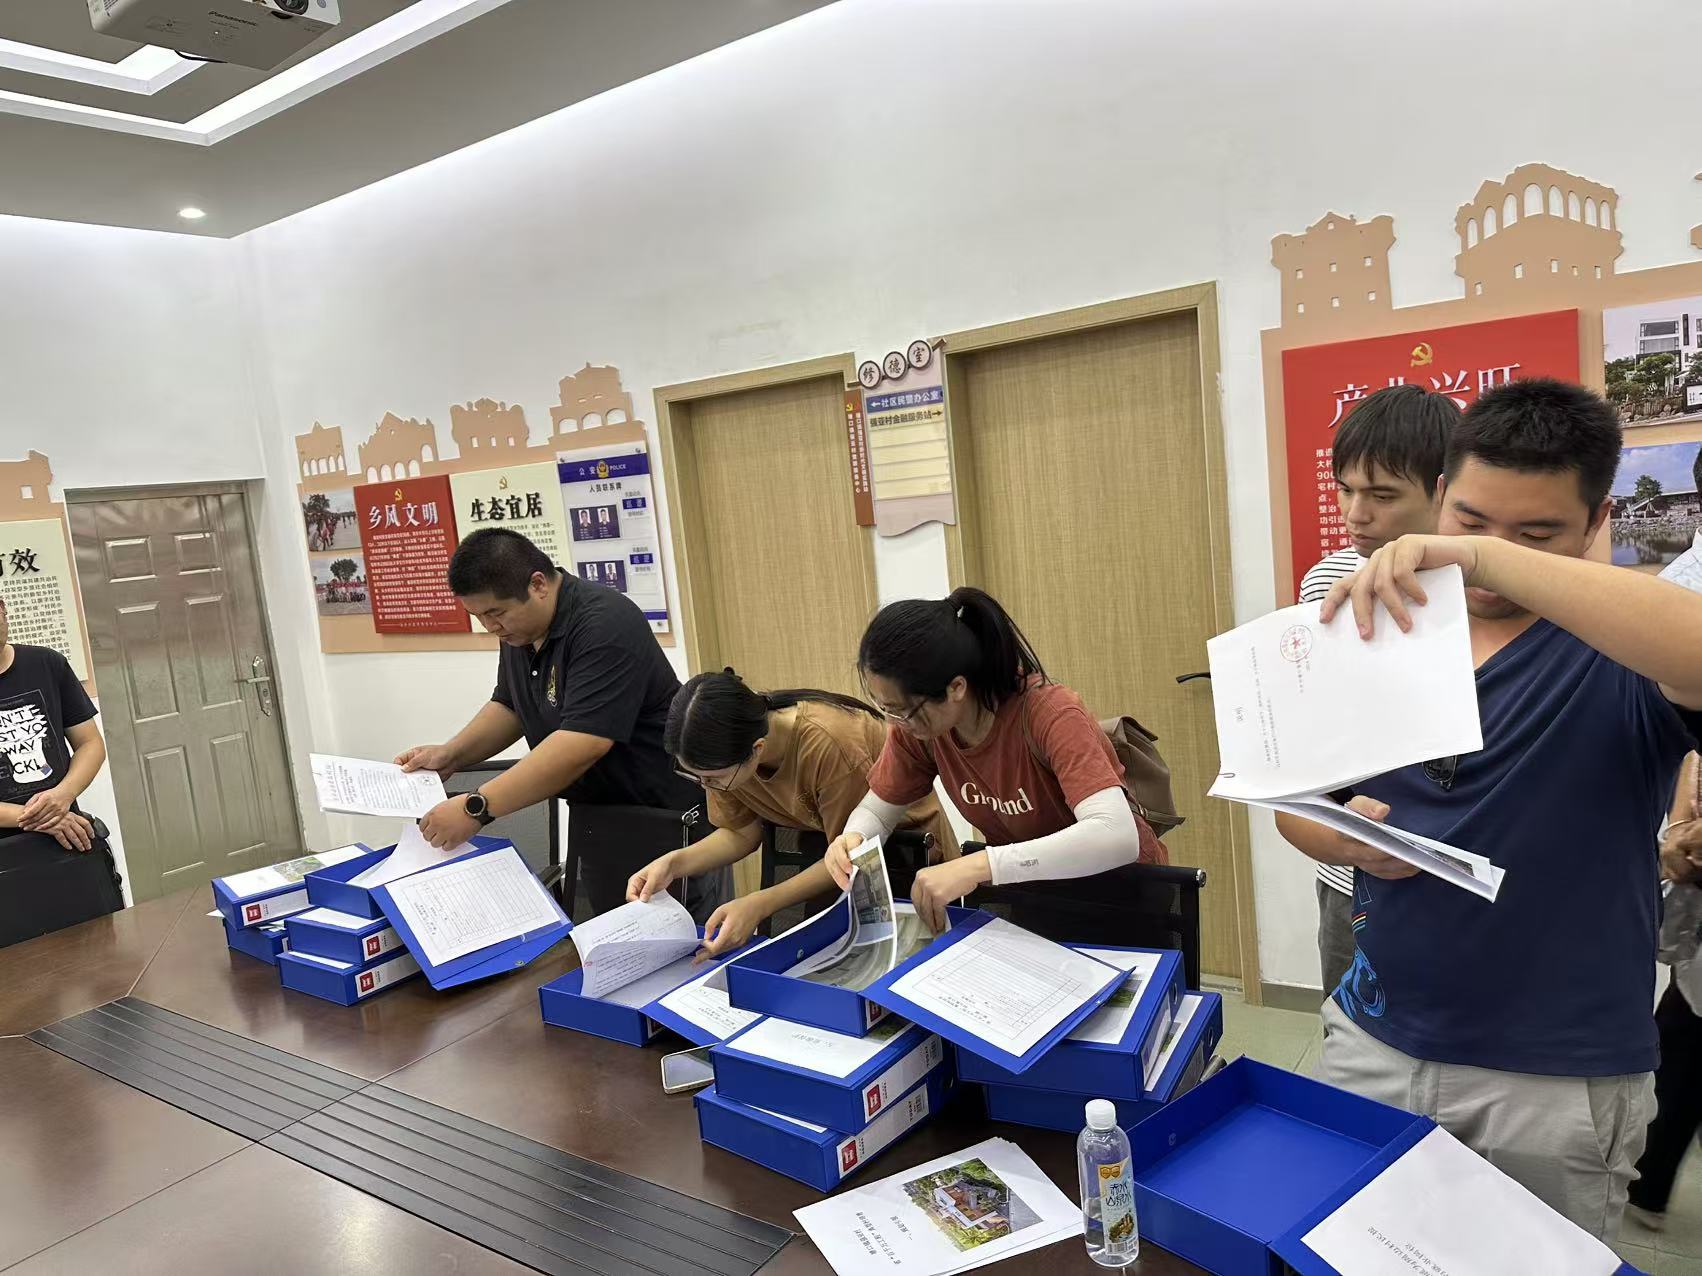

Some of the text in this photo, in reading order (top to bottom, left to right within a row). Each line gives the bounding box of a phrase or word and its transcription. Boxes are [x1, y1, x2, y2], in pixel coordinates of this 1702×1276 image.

[881, 390, 939, 408] 社区民警办公室
[610, 463, 627, 471] POLICE
[368, 501, 439, 529] 乡风文明
[471, 492, 543, 522] 生态宜居
